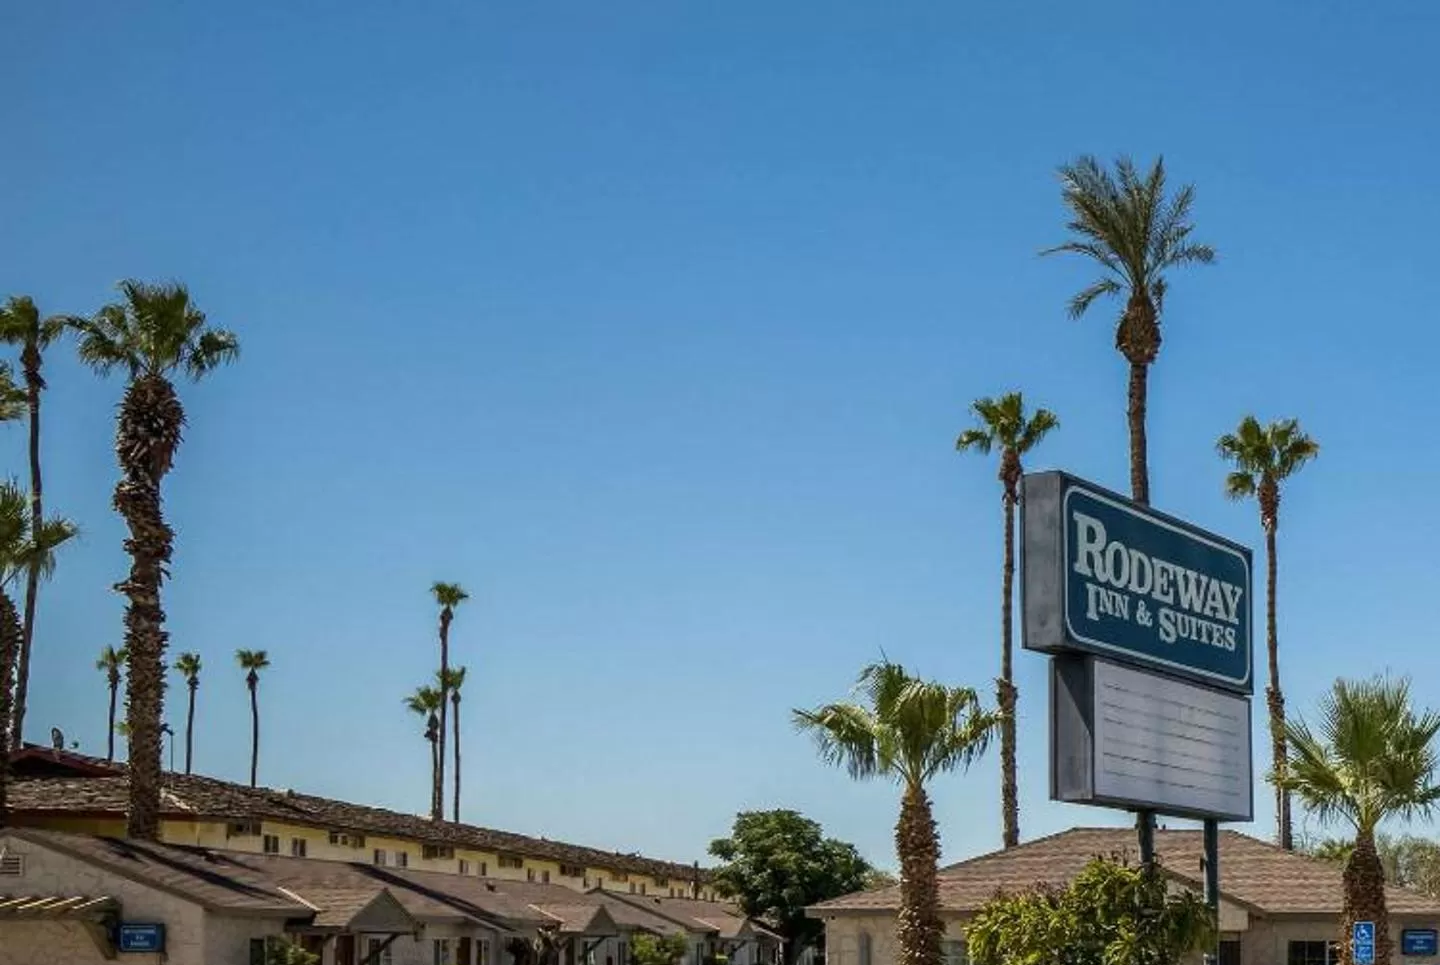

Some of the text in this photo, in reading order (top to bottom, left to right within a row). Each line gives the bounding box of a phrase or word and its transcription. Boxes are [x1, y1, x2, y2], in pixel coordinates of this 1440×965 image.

[1072, 510, 1243, 625] RODEWAY
[1085, 582, 1236, 652] INN & SUITES
